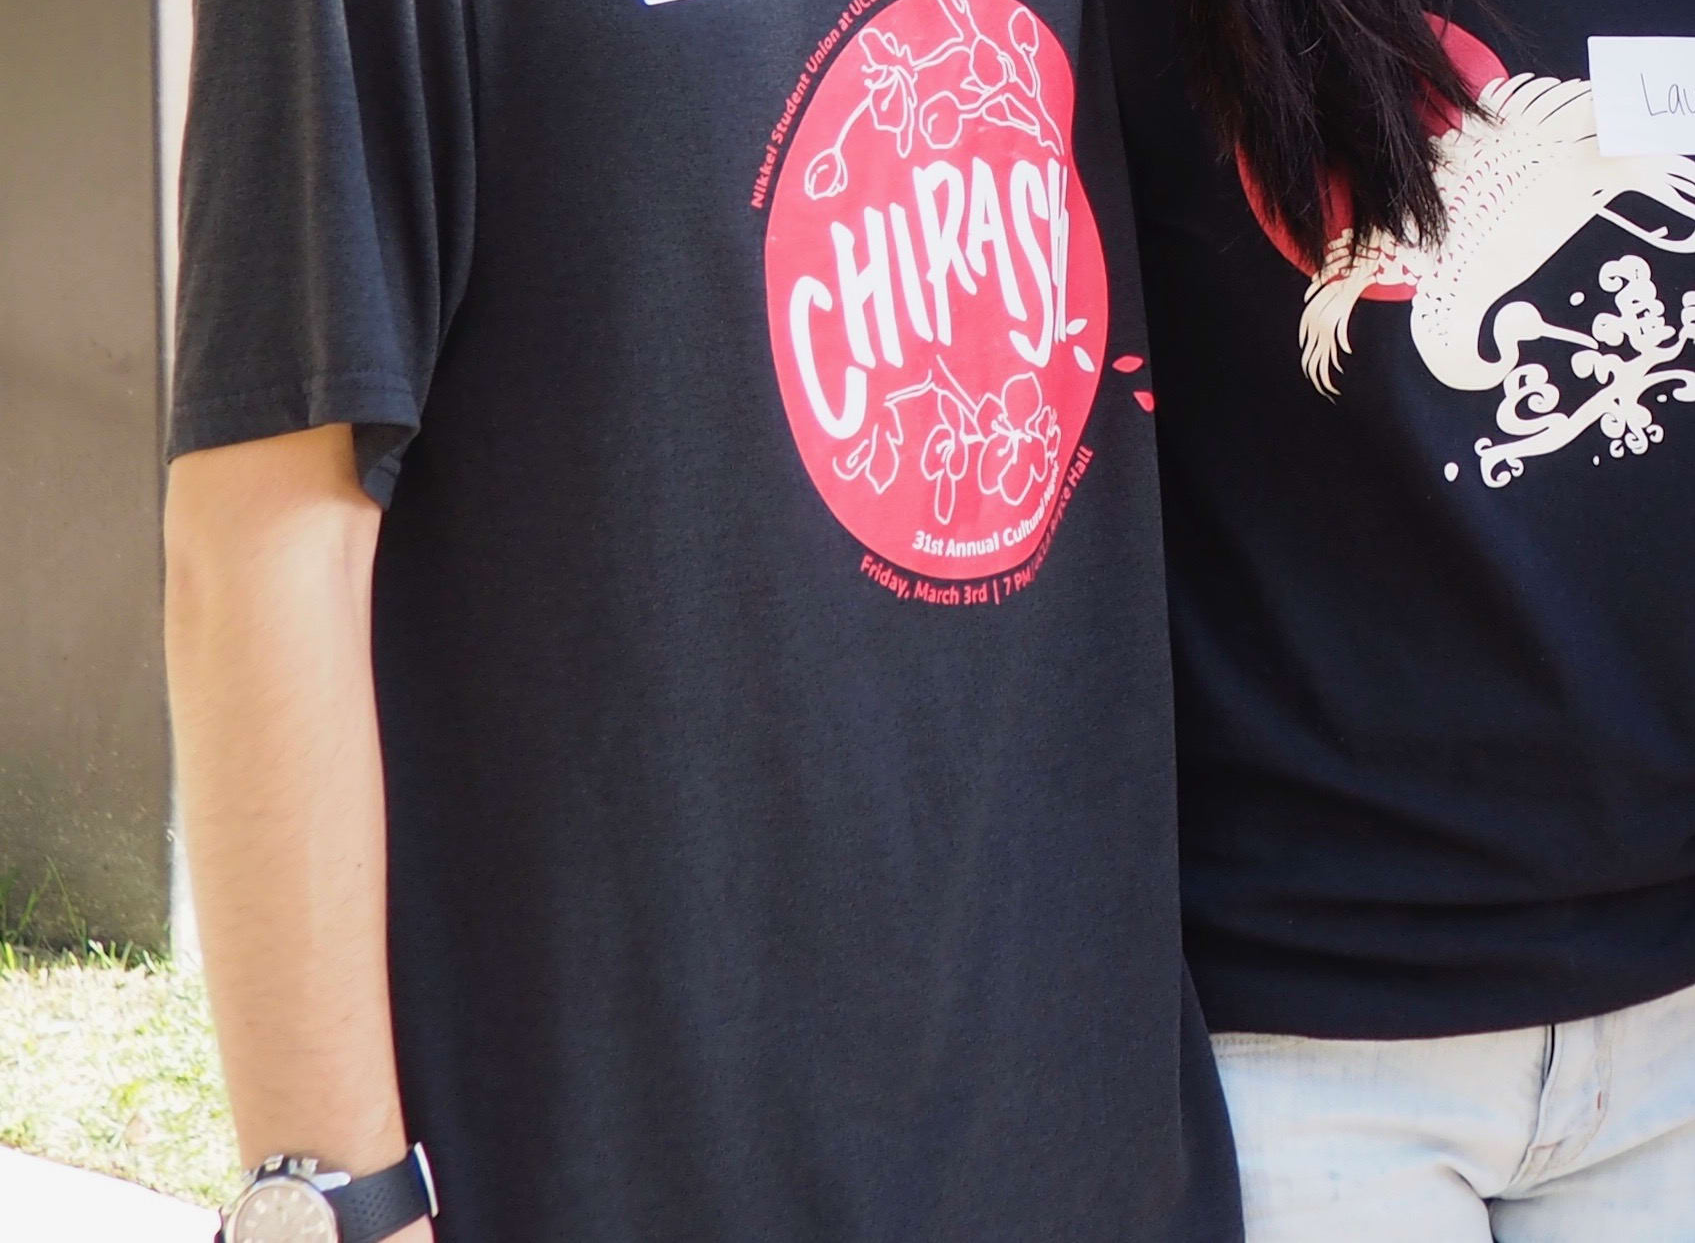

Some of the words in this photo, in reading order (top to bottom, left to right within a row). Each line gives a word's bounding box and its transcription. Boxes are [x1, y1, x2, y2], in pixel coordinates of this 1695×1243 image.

[751, 145, 779, 209] Nikkei
[771, 72, 811, 145] Student
[806, 28, 841, 74] Union
[837, 10, 854, 32] at
[860, 554, 911, 600] Friday,
[913, 579, 960, 605] March
[962, 583, 988, 605] 3rd
[1003, 579, 1012, 597] 7
[1013, 568, 1032, 592] PM
[1067, 444, 1094, 488] Hall
[912, 530, 945, 557] 31st
[944, 532, 1000, 558] Annual
[1002, 500, 1046, 548] Cultural
